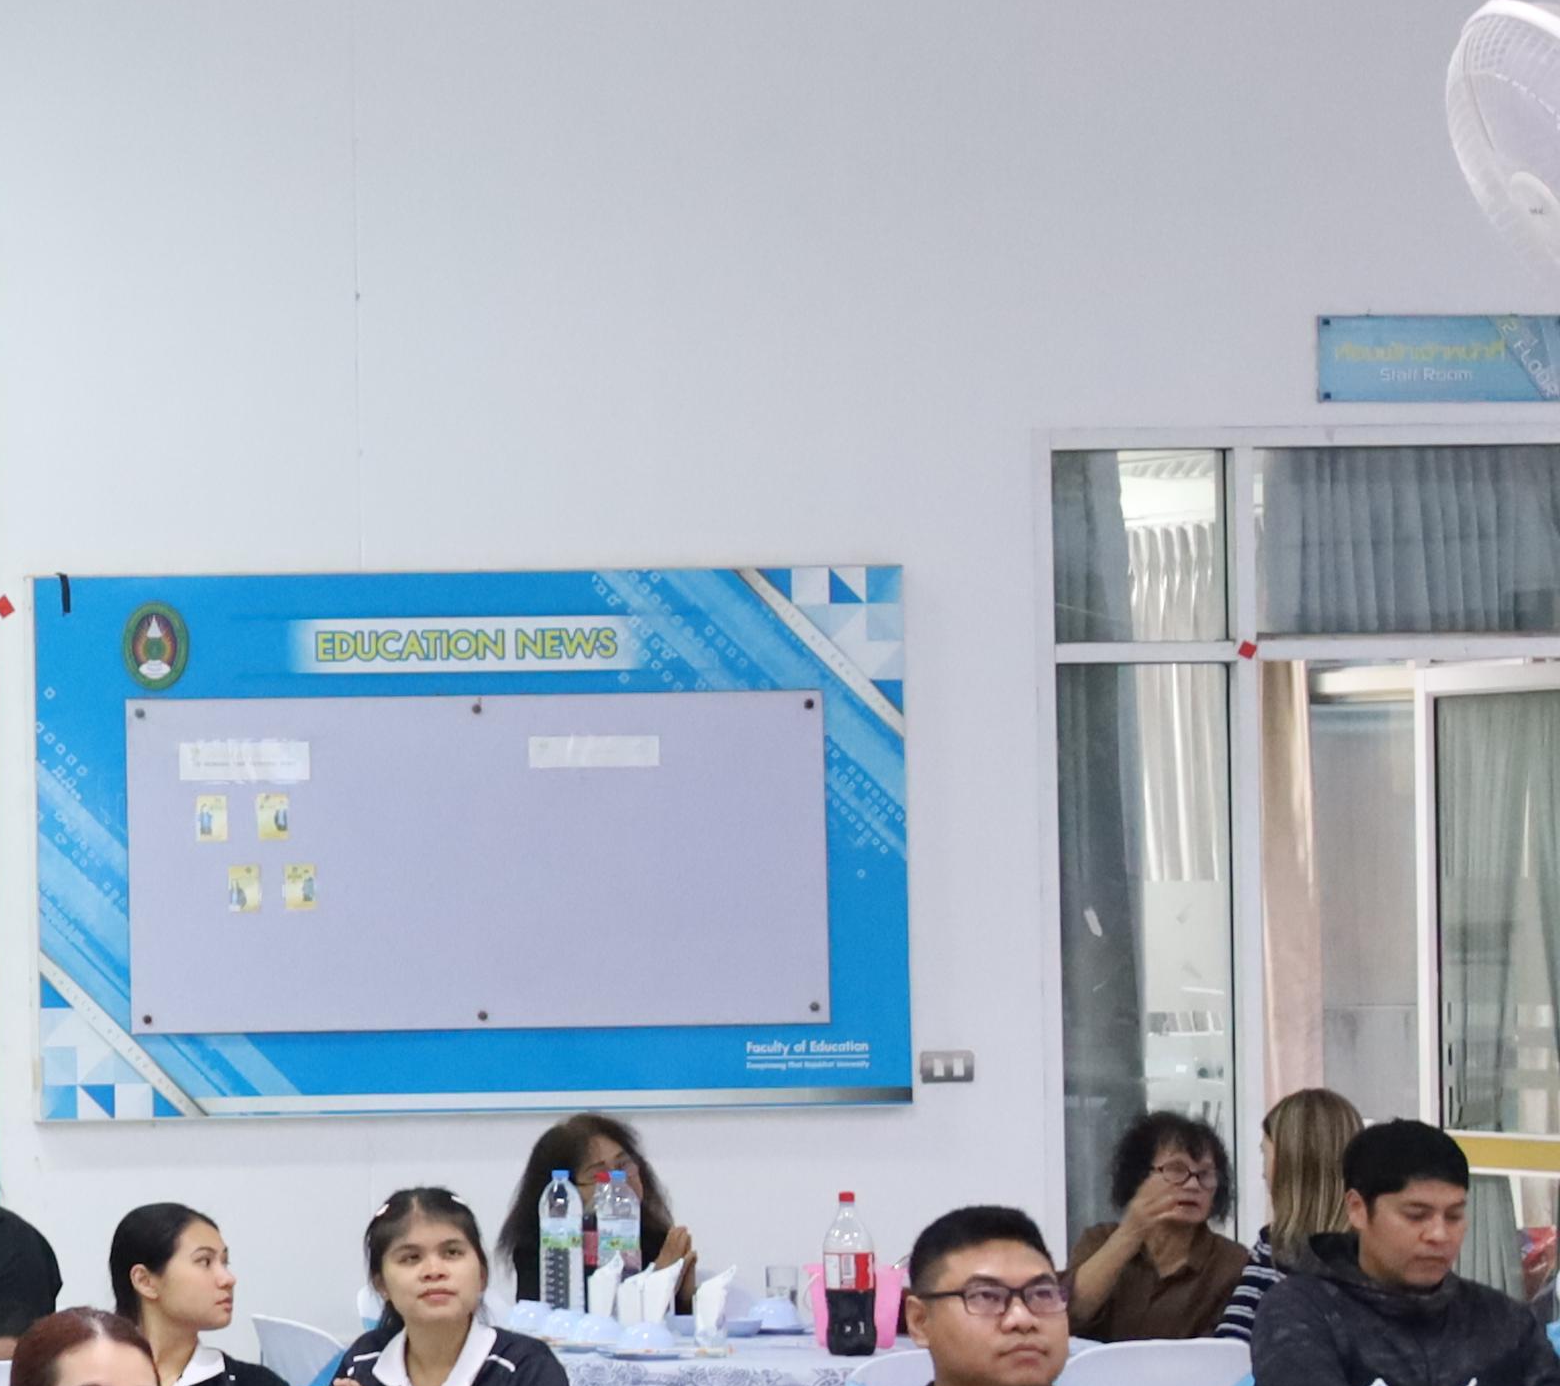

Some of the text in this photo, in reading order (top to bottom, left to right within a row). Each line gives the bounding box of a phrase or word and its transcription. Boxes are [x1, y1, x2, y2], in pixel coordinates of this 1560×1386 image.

[1380, 366, 1473, 382] Staff Room
[316, 626, 618, 662] EDUCATION NEWS
[746, 1039, 869, 1056] Faculty of Education
